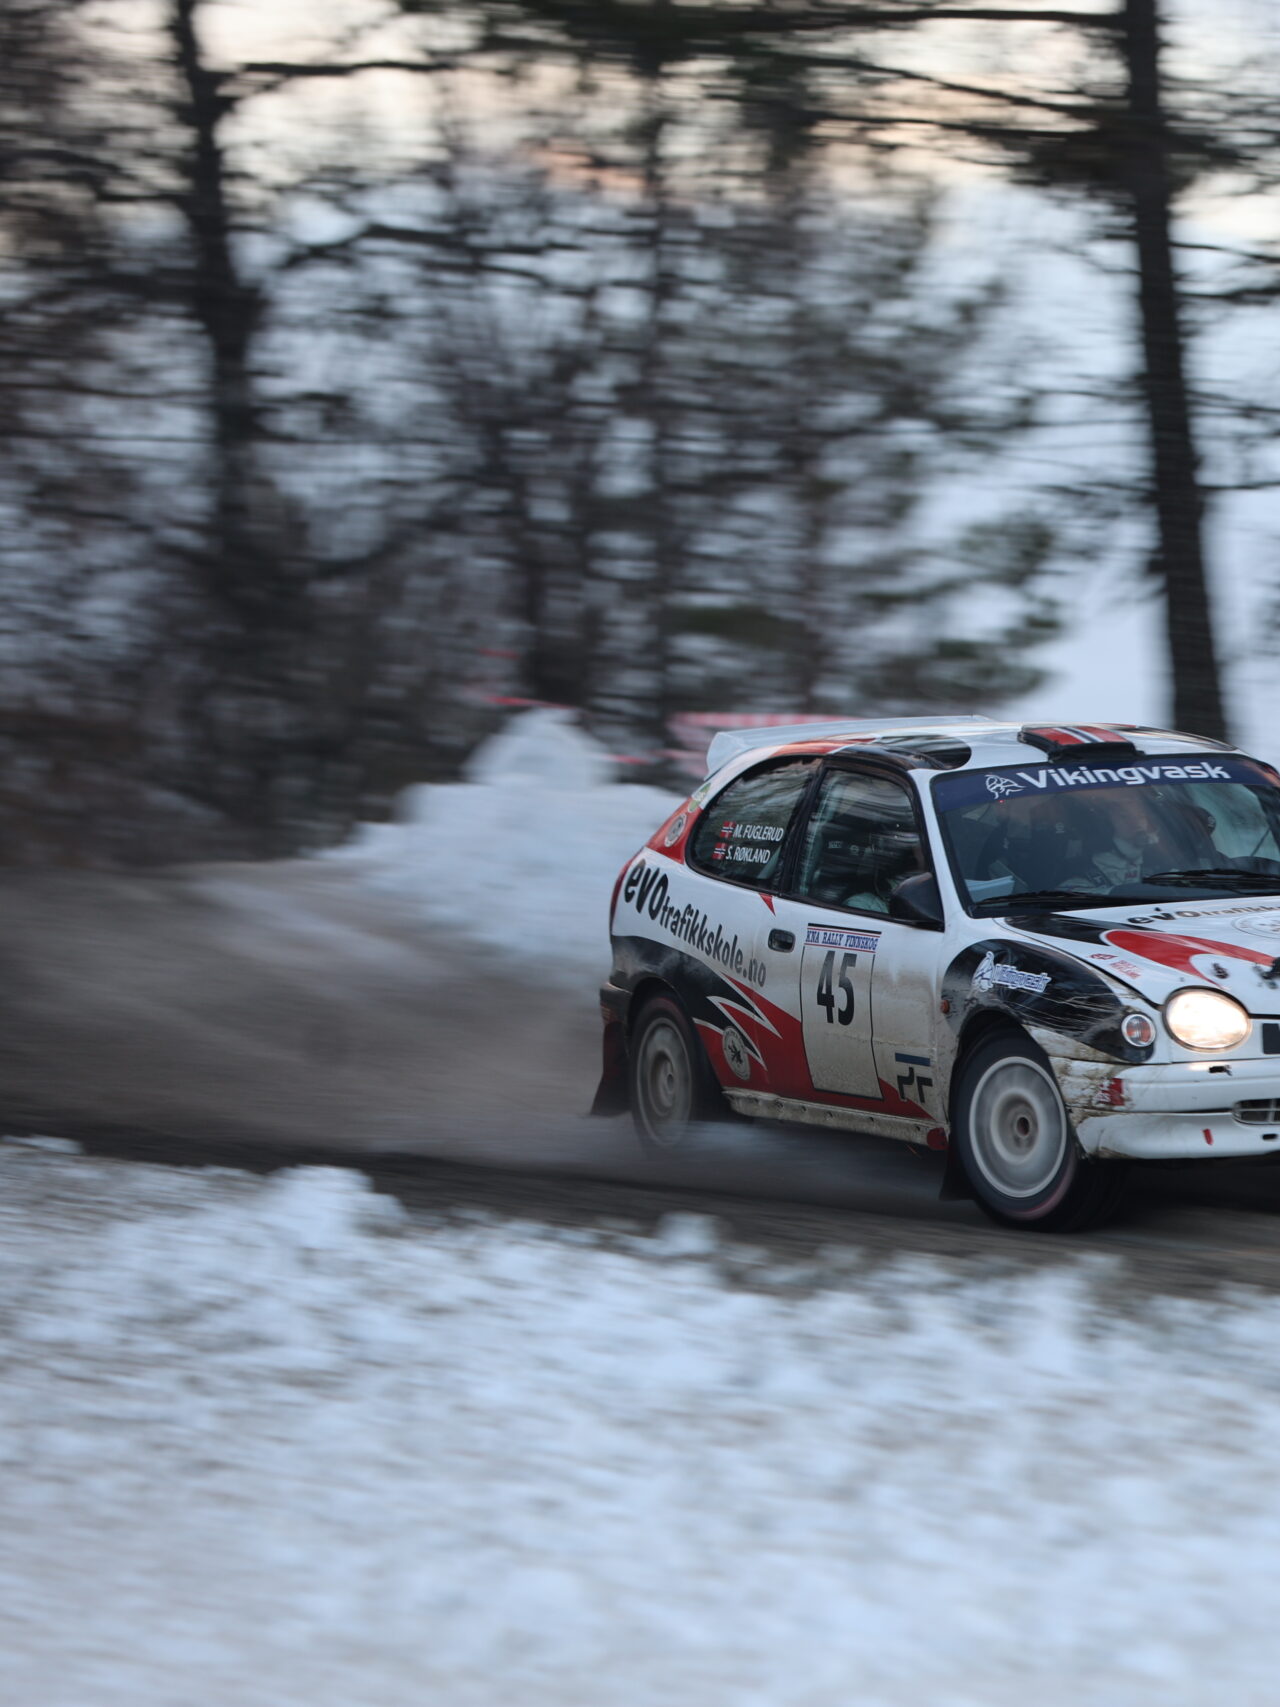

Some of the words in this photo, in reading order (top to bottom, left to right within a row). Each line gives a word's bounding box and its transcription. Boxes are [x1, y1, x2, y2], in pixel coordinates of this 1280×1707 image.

[1016, 762, 1232, 788] Vikingvask
[733, 824, 743, 839] M.
[743, 824, 785, 842] FUGLERUD
[725, 845, 733, 860] S.
[733, 846, 771, 864] RØKLAND
[624, 858, 767, 987] evotrafikkskole.no
[805, 930, 820, 943] KNA
[822, 932, 845, 946] RALLY
[845, 934, 879, 951] FINNSKOG
[816, 950, 858, 1026] 45
